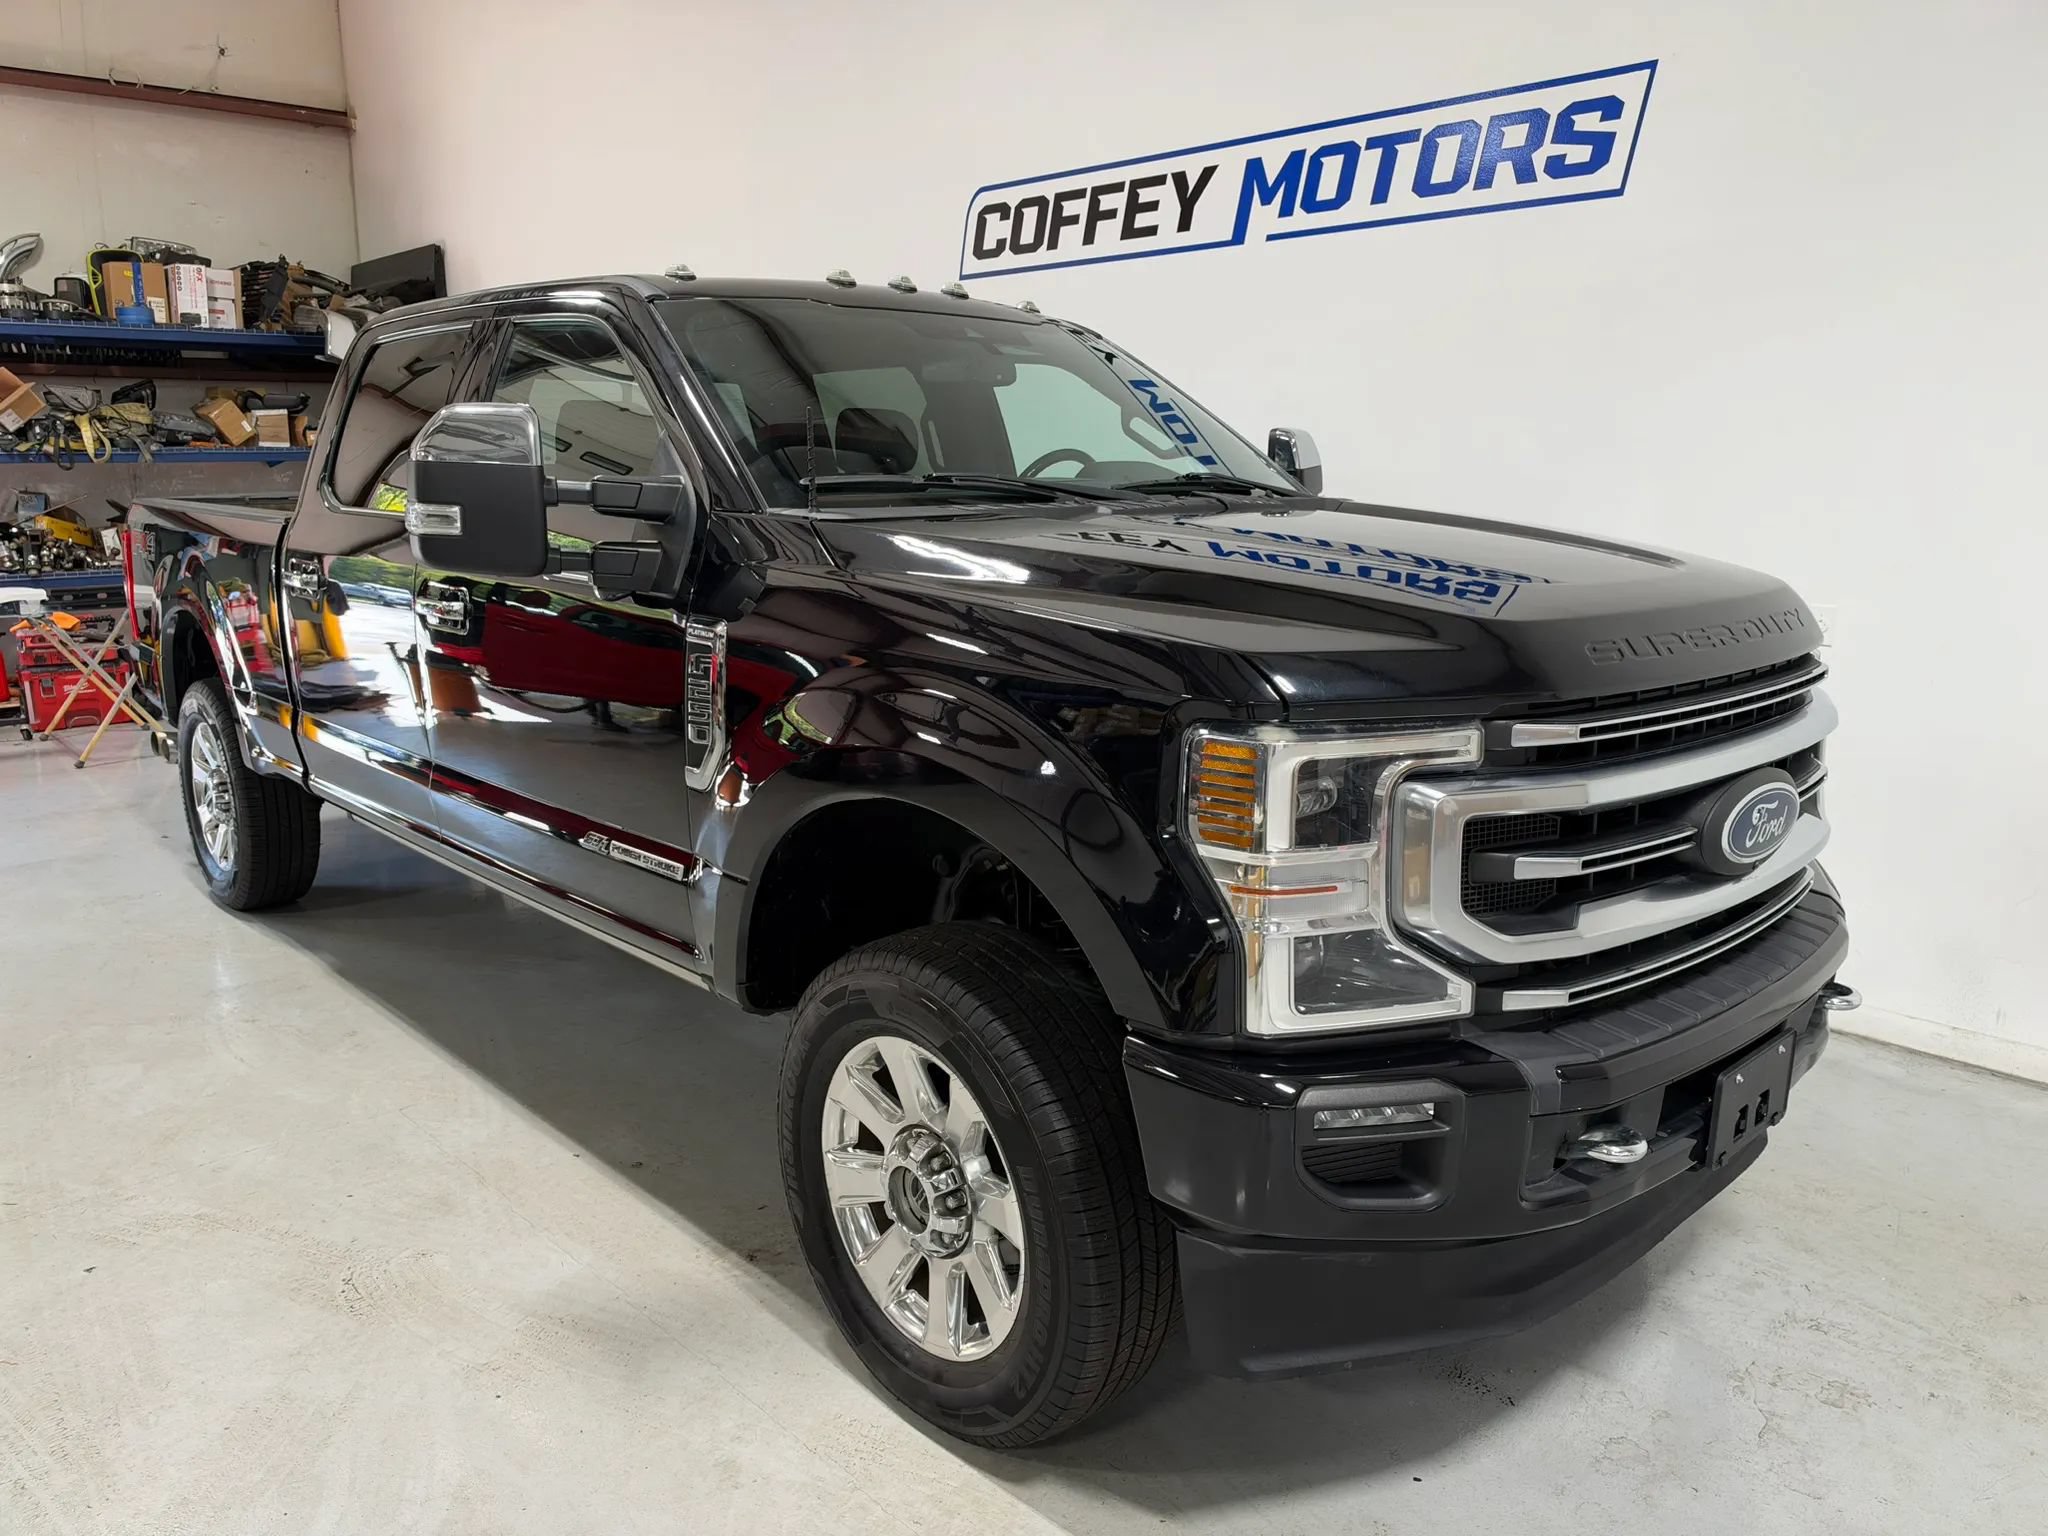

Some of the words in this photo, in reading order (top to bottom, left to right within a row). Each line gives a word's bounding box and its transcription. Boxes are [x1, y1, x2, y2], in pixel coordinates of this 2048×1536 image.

[972, 165, 1219, 261] COFFEY
[1230, 95, 1625, 245] MOTORS
[688, 627, 715, 638] PLATINUM
[1745, 799, 1788, 848] Ford
[642, 854, 680, 875] STROKE
